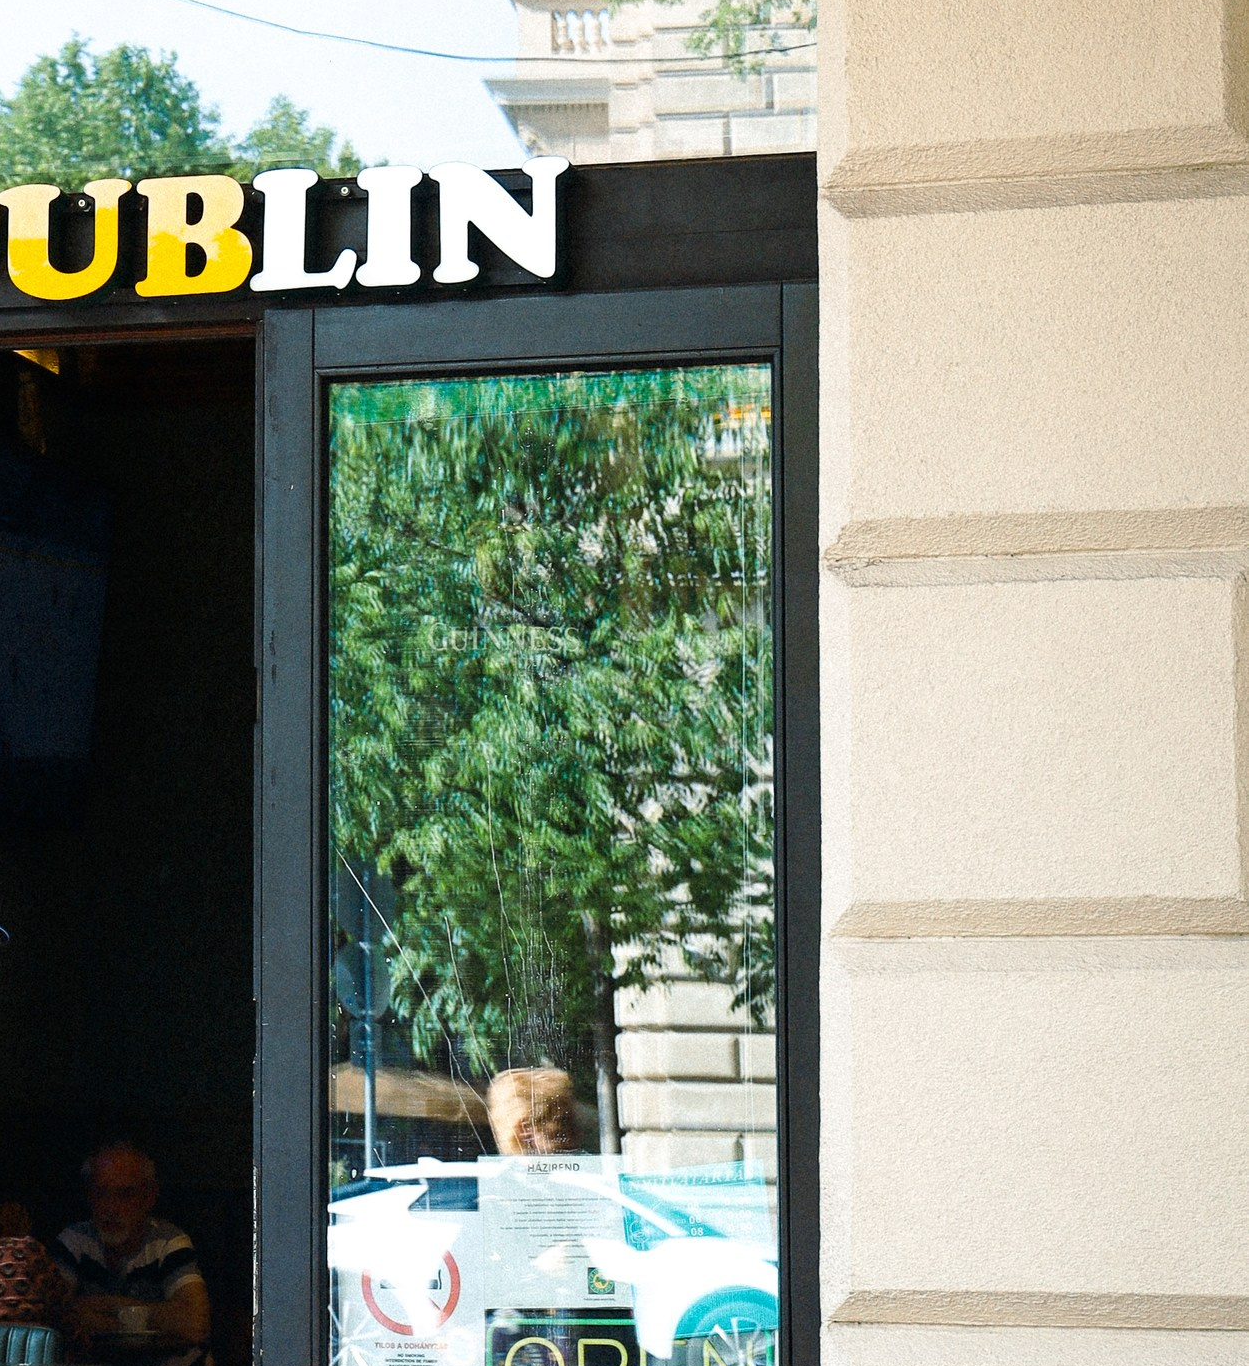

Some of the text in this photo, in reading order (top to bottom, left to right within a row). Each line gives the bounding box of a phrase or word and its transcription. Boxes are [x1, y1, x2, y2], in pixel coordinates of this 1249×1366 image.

[428, 622, 581, 652] GUINNESS
[526, 1161, 581, 1173] HÁZIREND
[375, 1342, 395, 1350] TILOS
[397, 1342, 403, 1350] A
